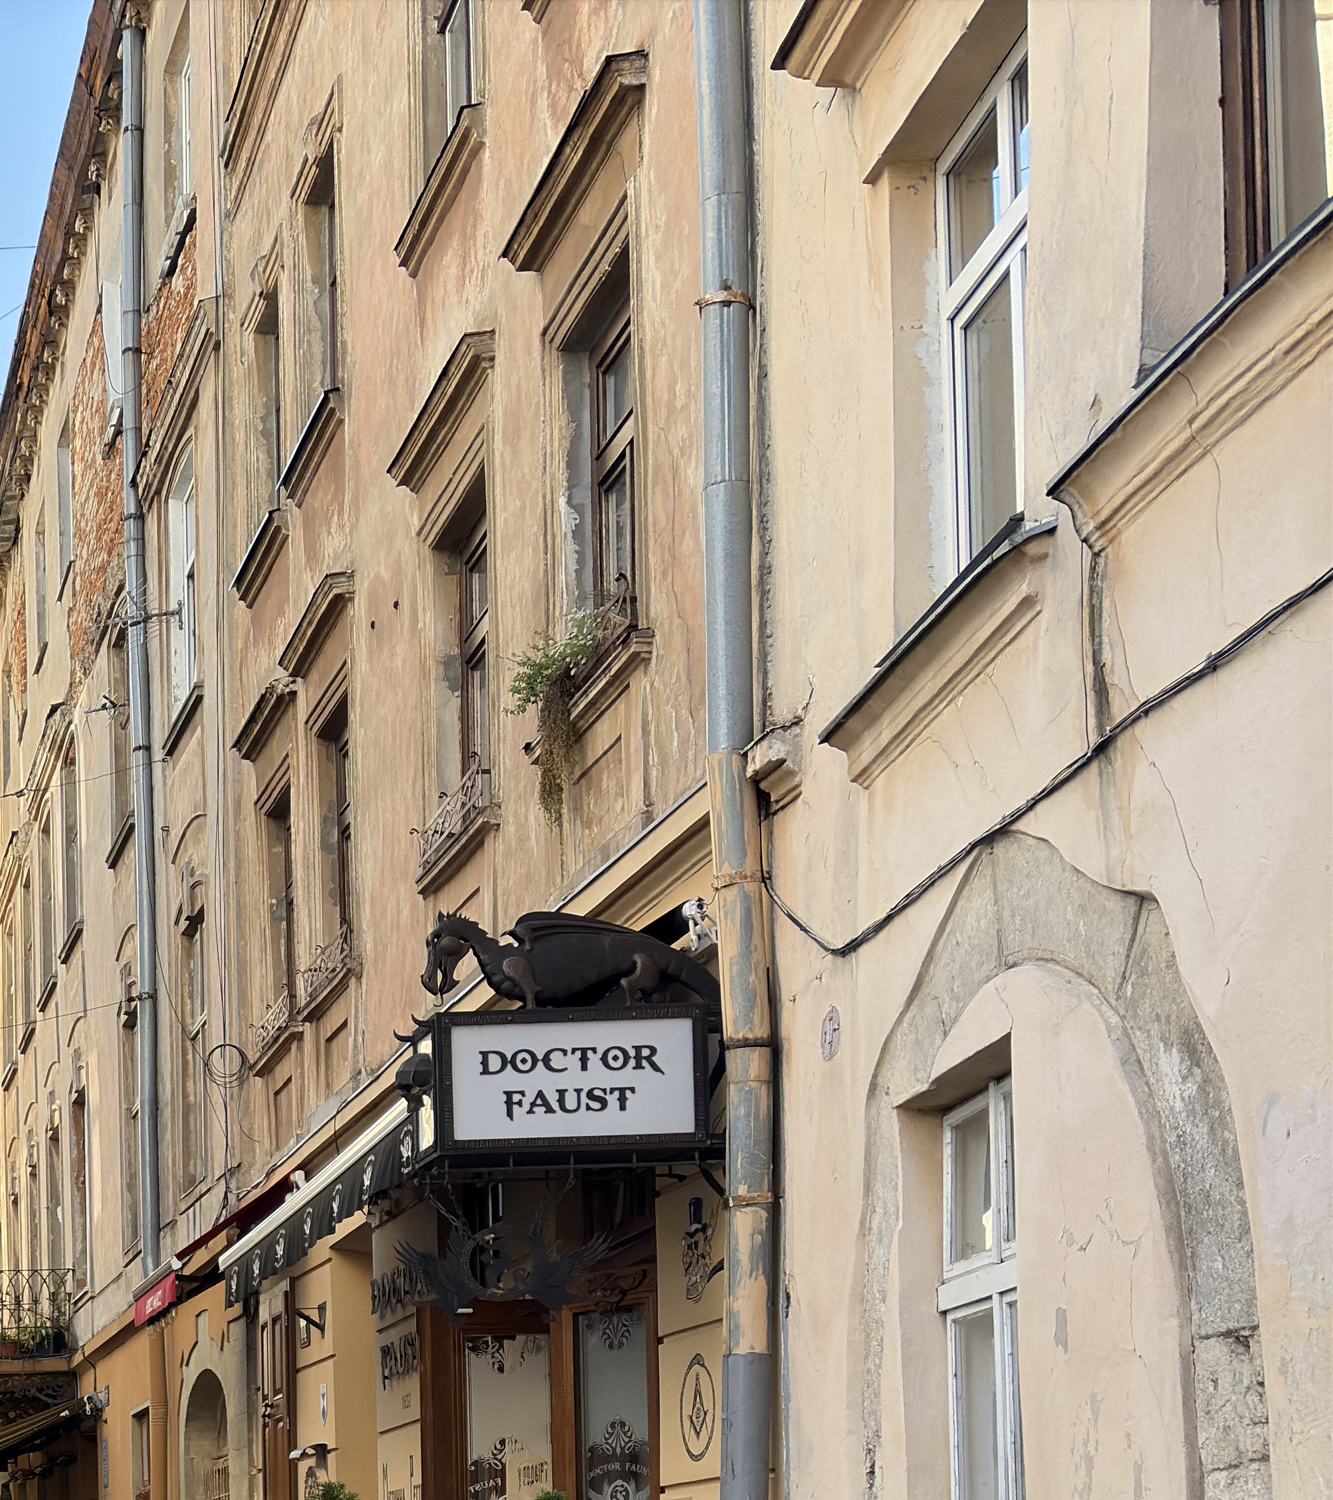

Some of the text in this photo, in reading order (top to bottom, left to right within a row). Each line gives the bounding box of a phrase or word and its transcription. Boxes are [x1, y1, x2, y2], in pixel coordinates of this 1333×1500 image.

[478, 1044, 666, 1076] DOCTOR
[502, 1085, 636, 1122] FAUST
[586, 1461, 621, 1481] DOCTOR
